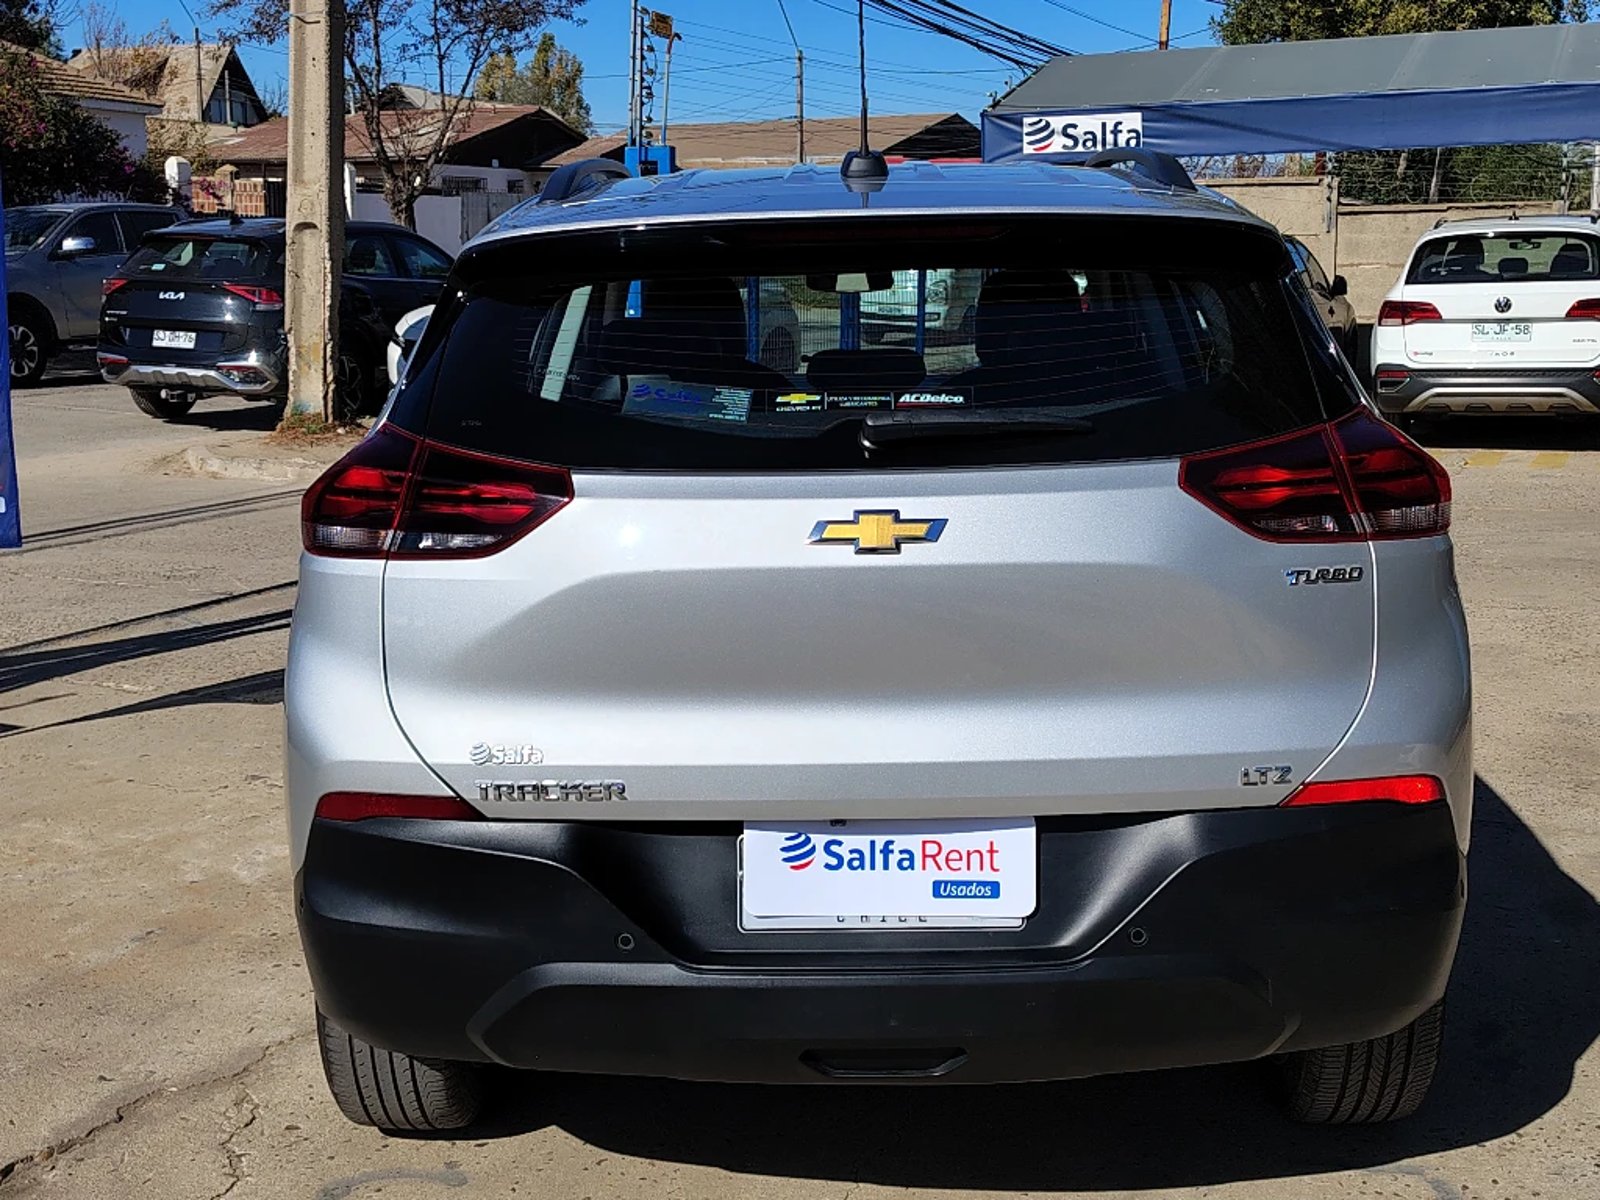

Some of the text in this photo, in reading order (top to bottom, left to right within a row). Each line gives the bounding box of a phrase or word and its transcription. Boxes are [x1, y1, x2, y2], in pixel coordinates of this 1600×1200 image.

[1061, 121, 1142, 151] Salfa
[899, 393, 965, 404] ACDelco
[1285, 567, 1364, 586] TURBO
[491, 745, 544, 765] Salfa
[1241, 765, 1292, 786] LTZ
[475, 779, 628, 802] TRACKER
[939, 882, 992, 897] Usados
